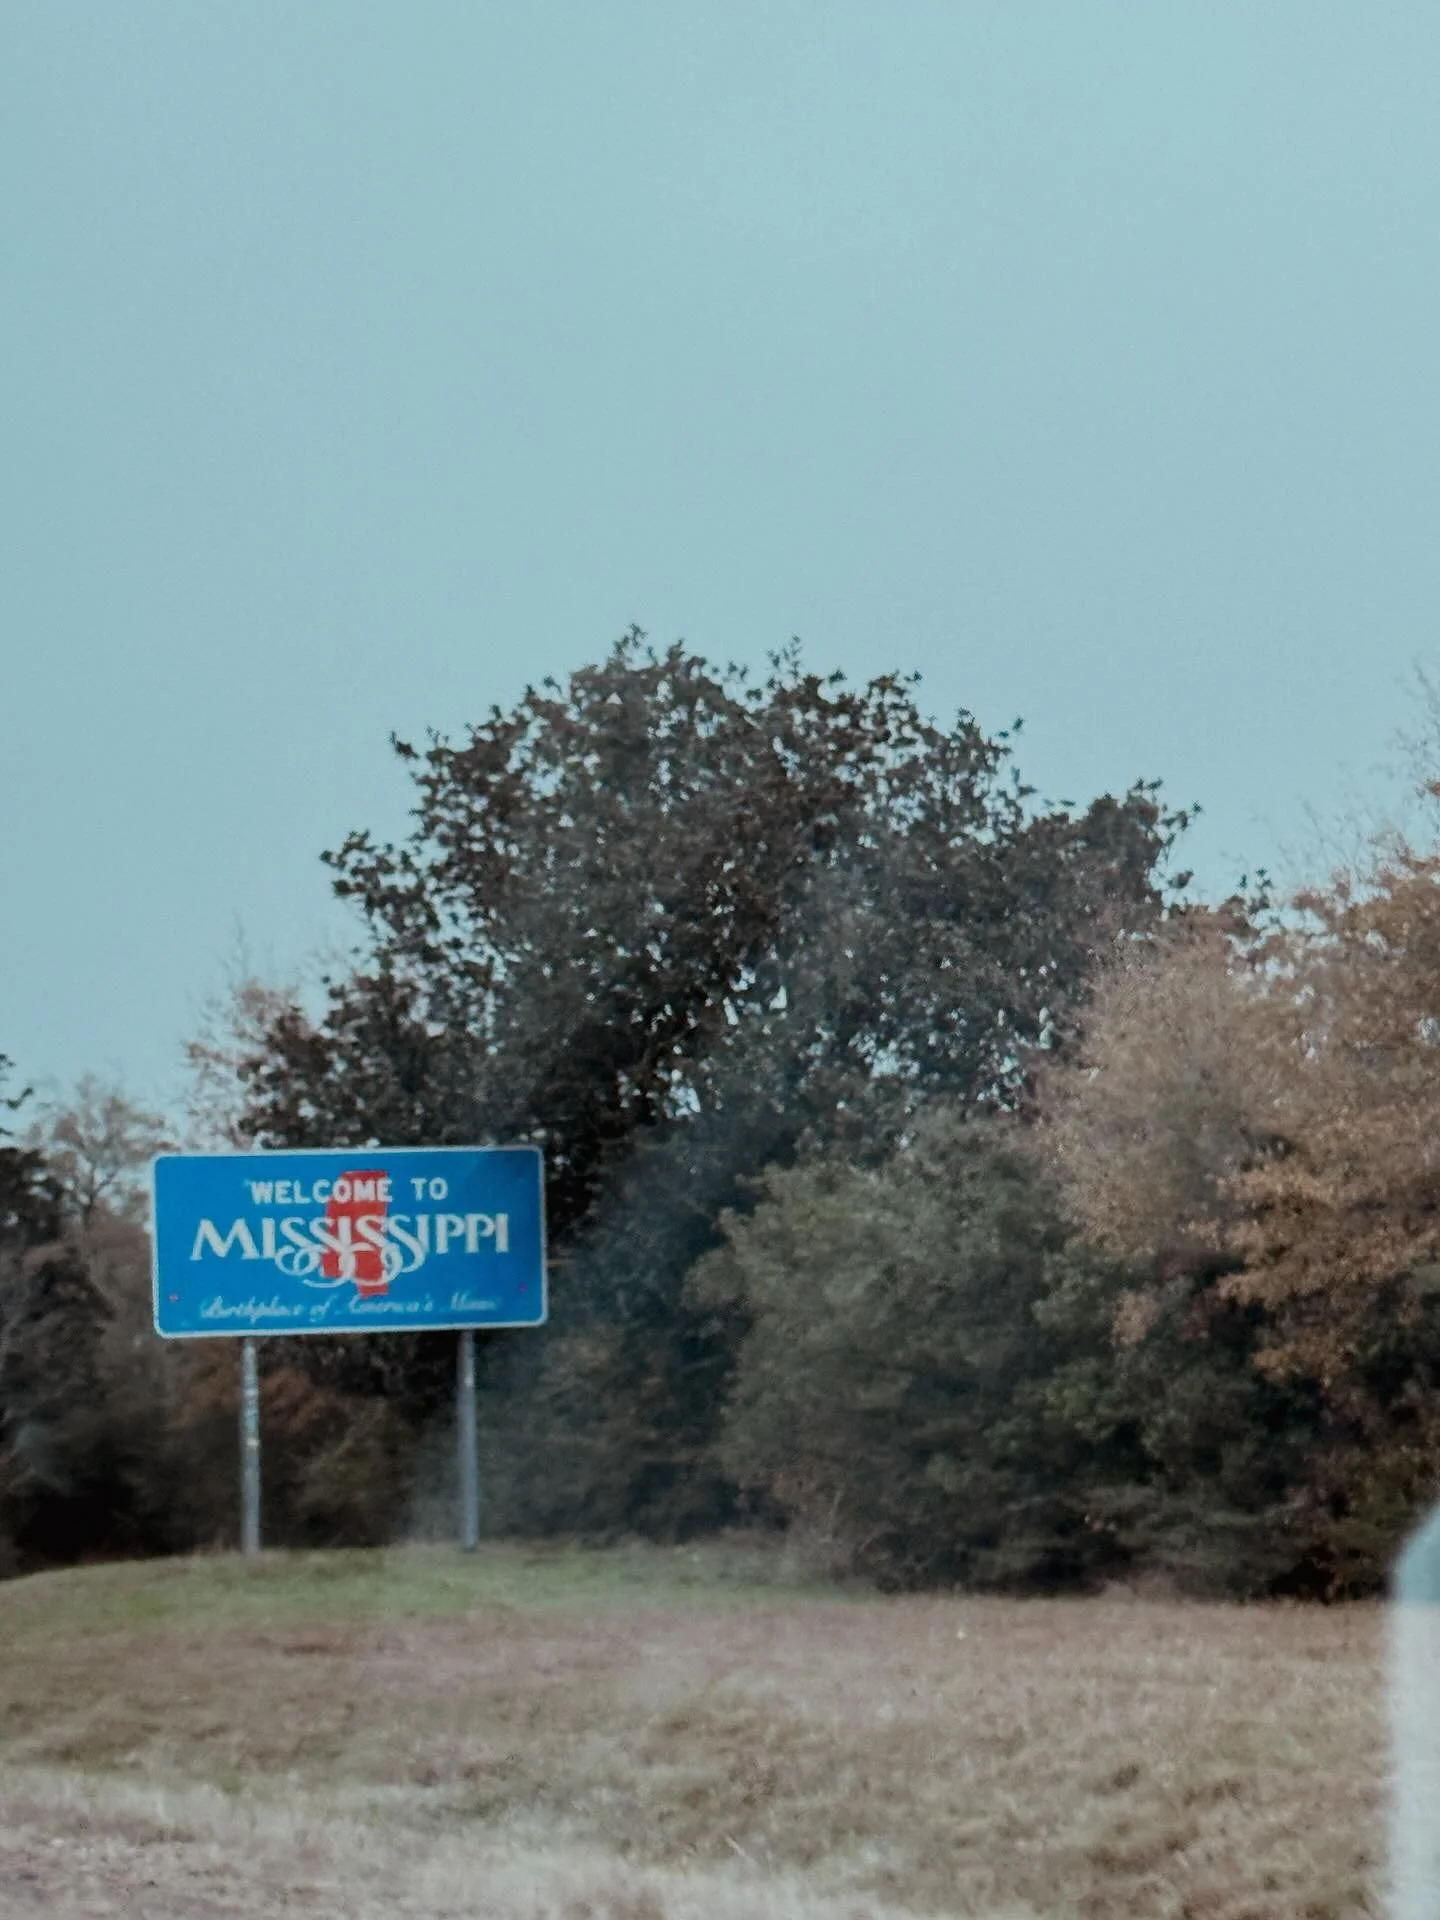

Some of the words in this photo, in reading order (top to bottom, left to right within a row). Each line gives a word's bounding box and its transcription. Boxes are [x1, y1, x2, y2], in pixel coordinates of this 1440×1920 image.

[250, 1178, 392, 1204] WELCOME
[410, 1177, 448, 1200] TO
[189, 1213, 509, 1288] MISSISSIPPI
